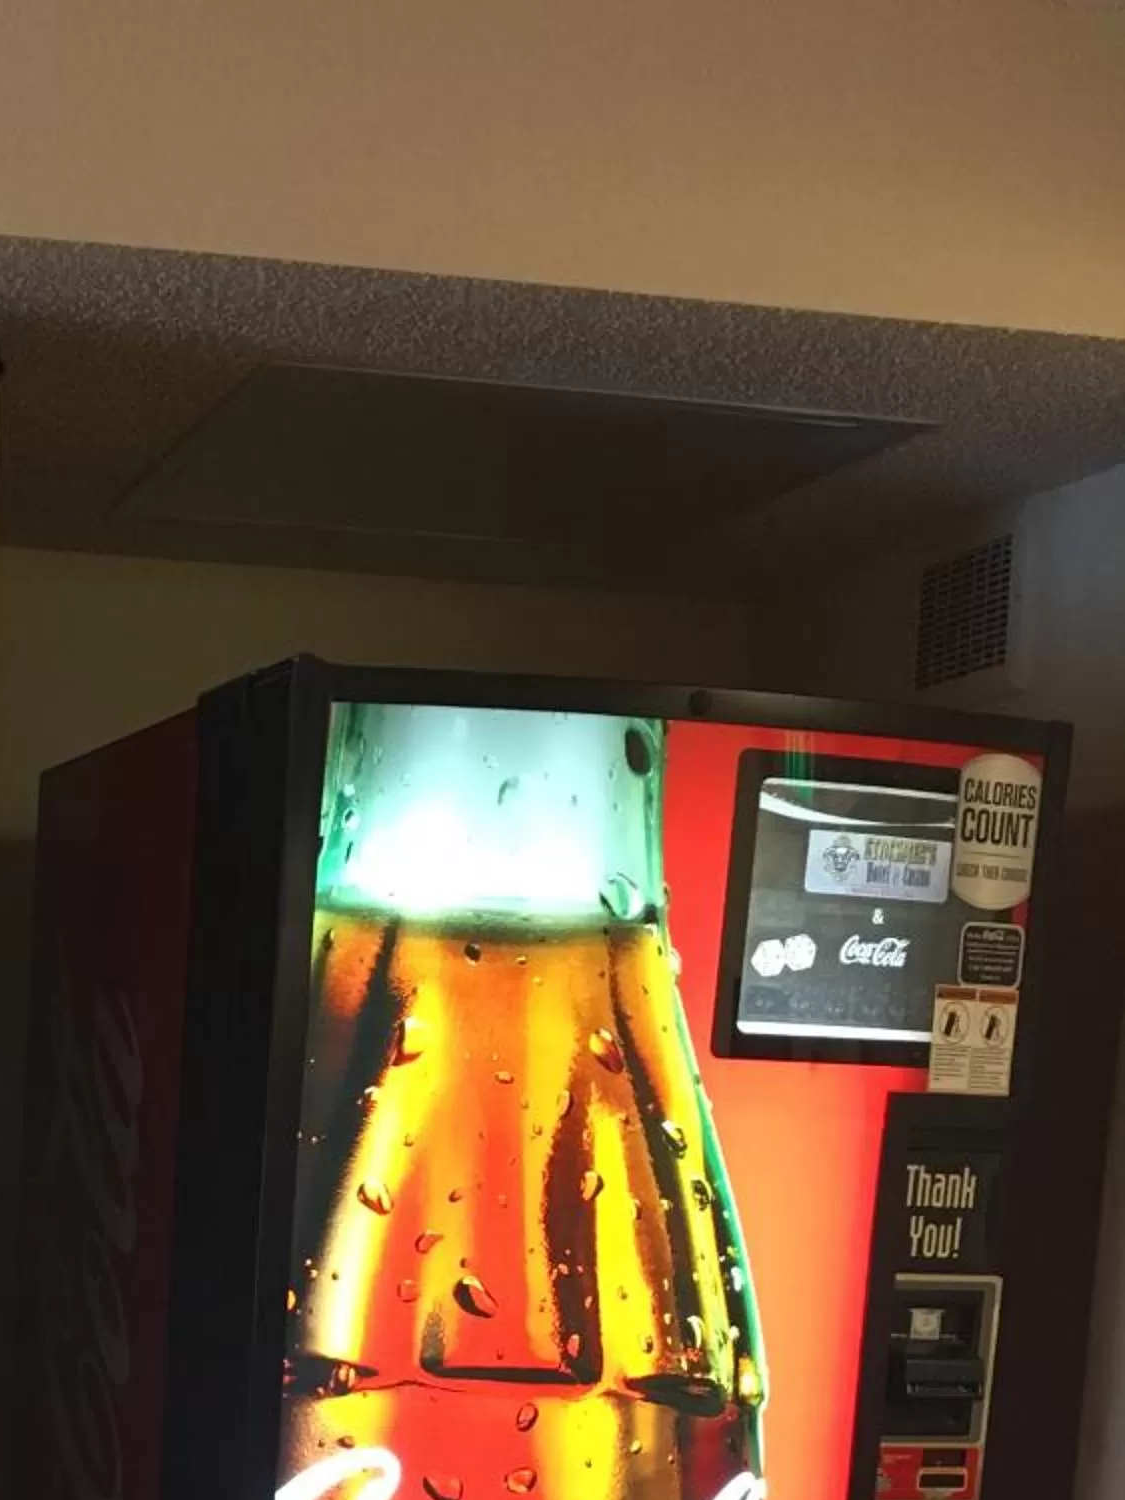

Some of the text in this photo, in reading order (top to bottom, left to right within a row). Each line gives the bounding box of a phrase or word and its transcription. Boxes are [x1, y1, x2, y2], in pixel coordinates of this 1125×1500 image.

[963, 778, 1037, 809] CALORIES
[960, 808, 1034, 848] COUNT
[872, 908, 884, 923] &
[906, 1164, 976, 1210] Thank
